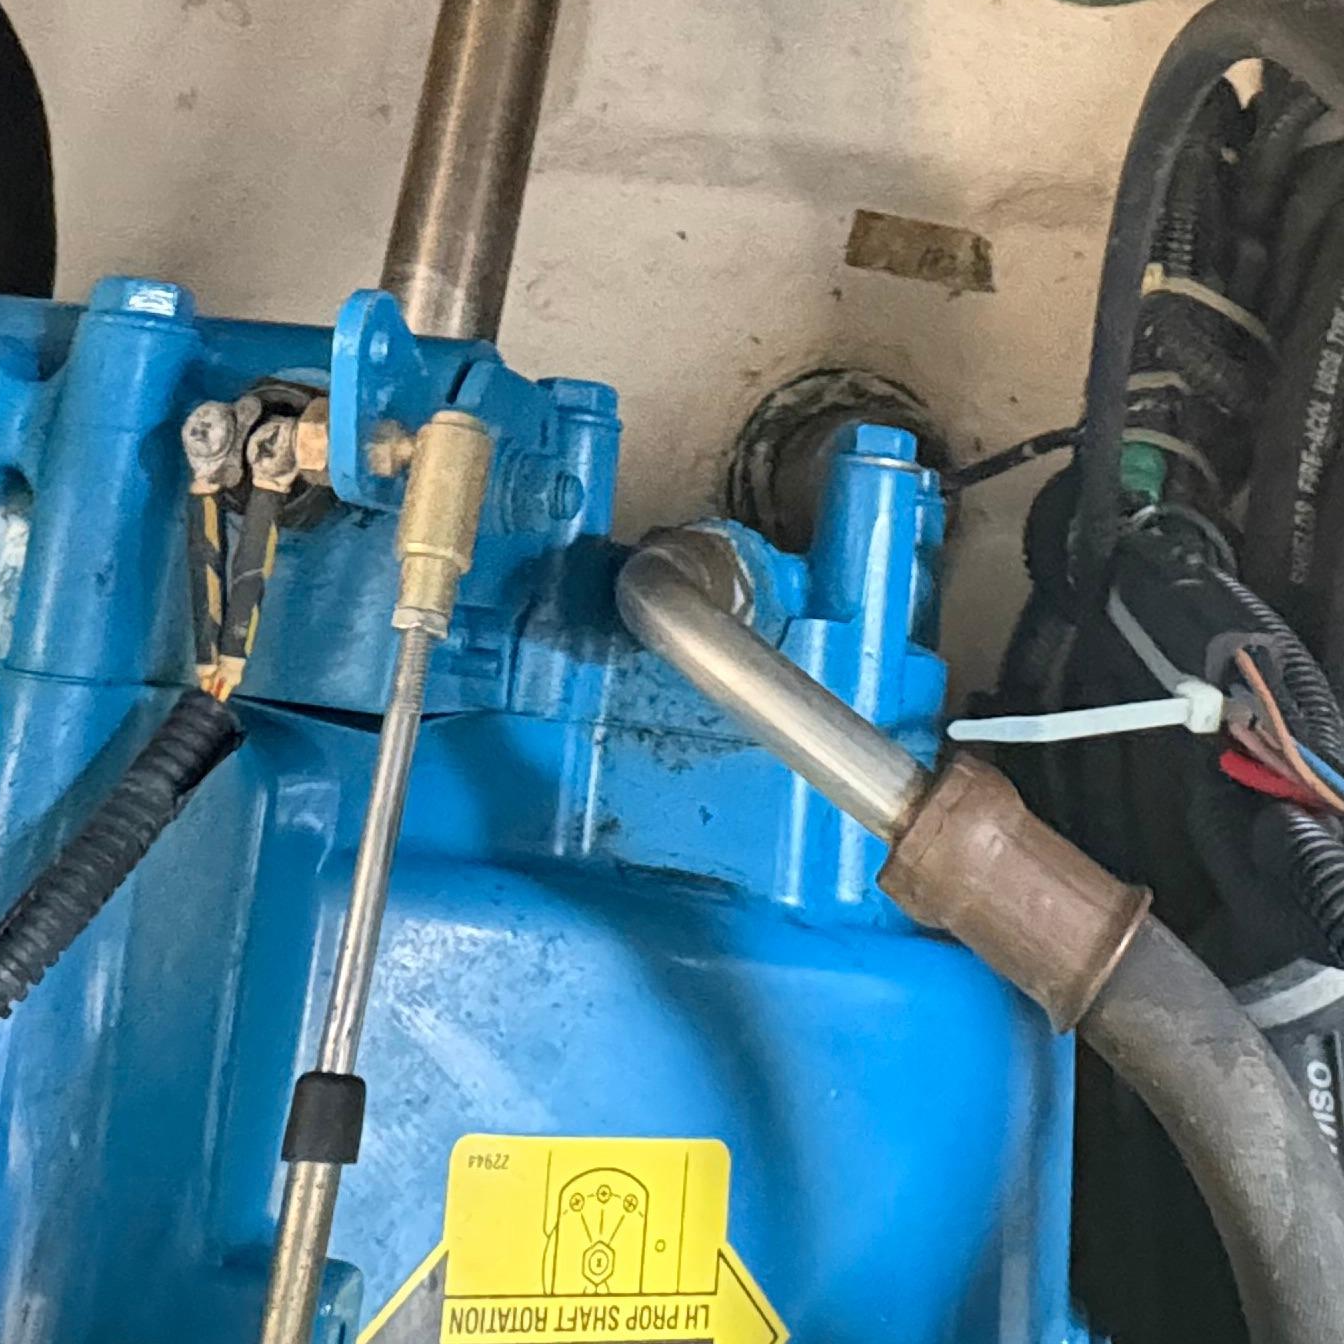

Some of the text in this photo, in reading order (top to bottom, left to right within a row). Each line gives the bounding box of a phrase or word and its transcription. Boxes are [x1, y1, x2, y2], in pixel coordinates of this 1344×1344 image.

[449, 1303, 710, 1335] LH PROP SHAFT ROTATION
